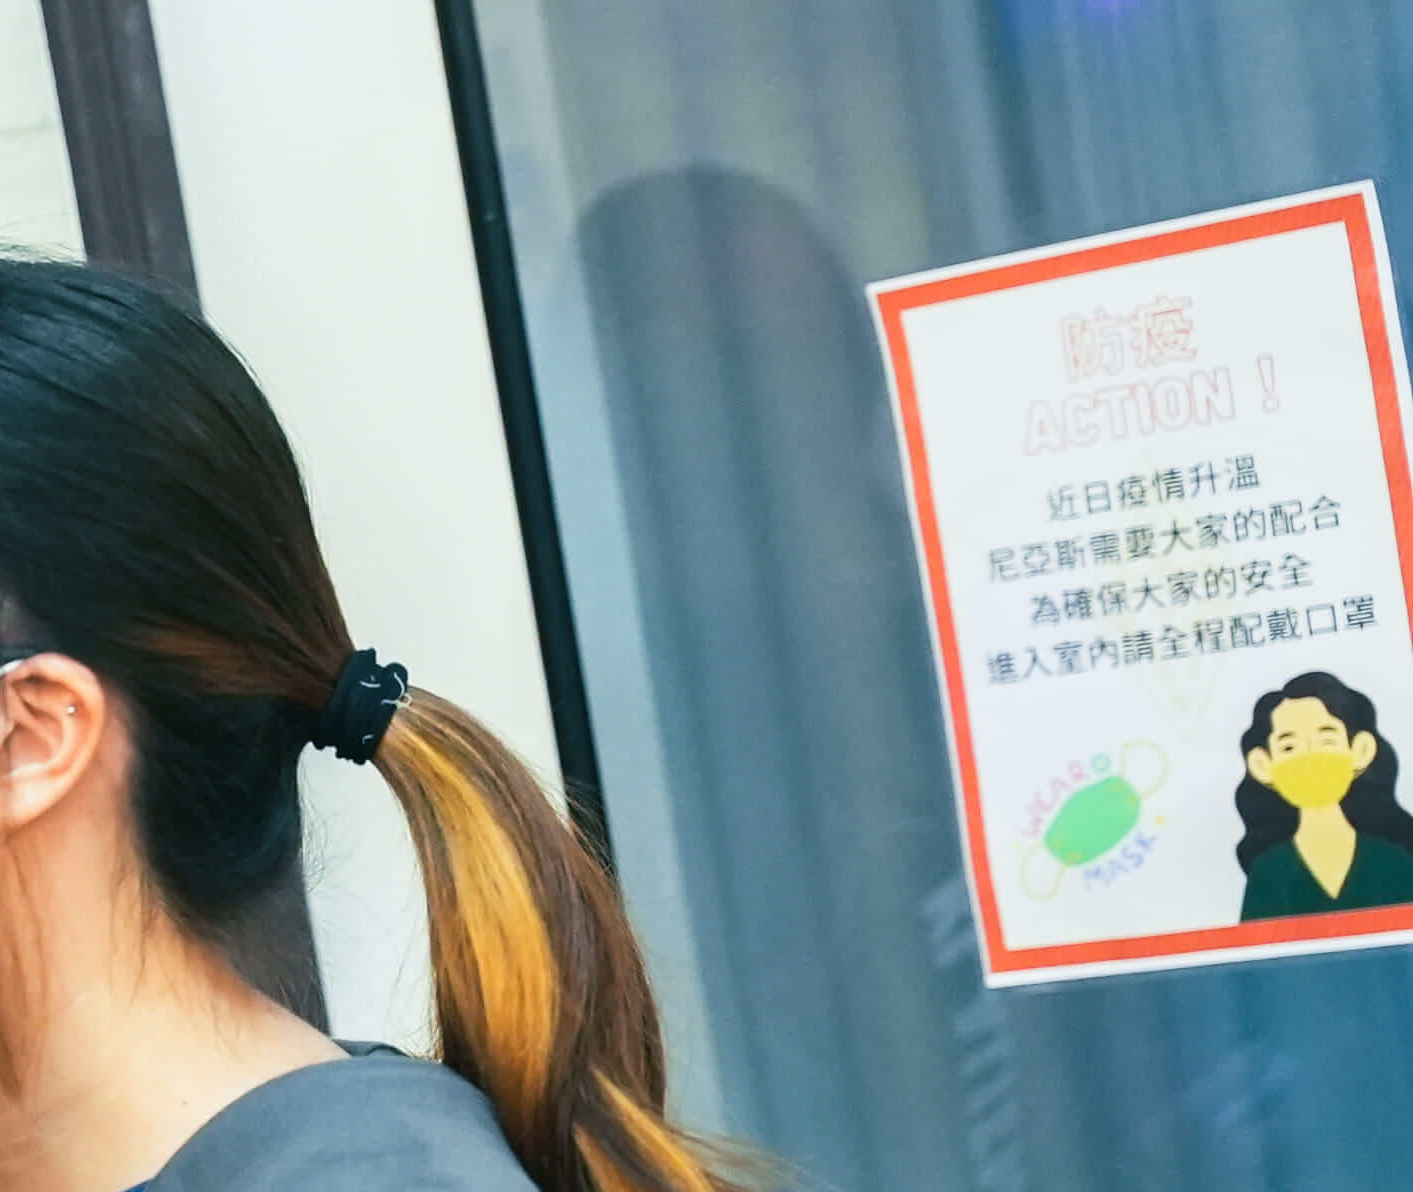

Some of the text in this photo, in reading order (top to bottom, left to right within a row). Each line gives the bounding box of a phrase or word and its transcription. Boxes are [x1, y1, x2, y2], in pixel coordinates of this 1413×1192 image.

[1060, 295, 1198, 383] 防疫
[1047, 453, 1261, 522] 近日疫情升溫
[987, 495, 1342, 584] 尼亞斯需要大家的配合
[1030, 552, 1315, 627] 為確保大家的安全
